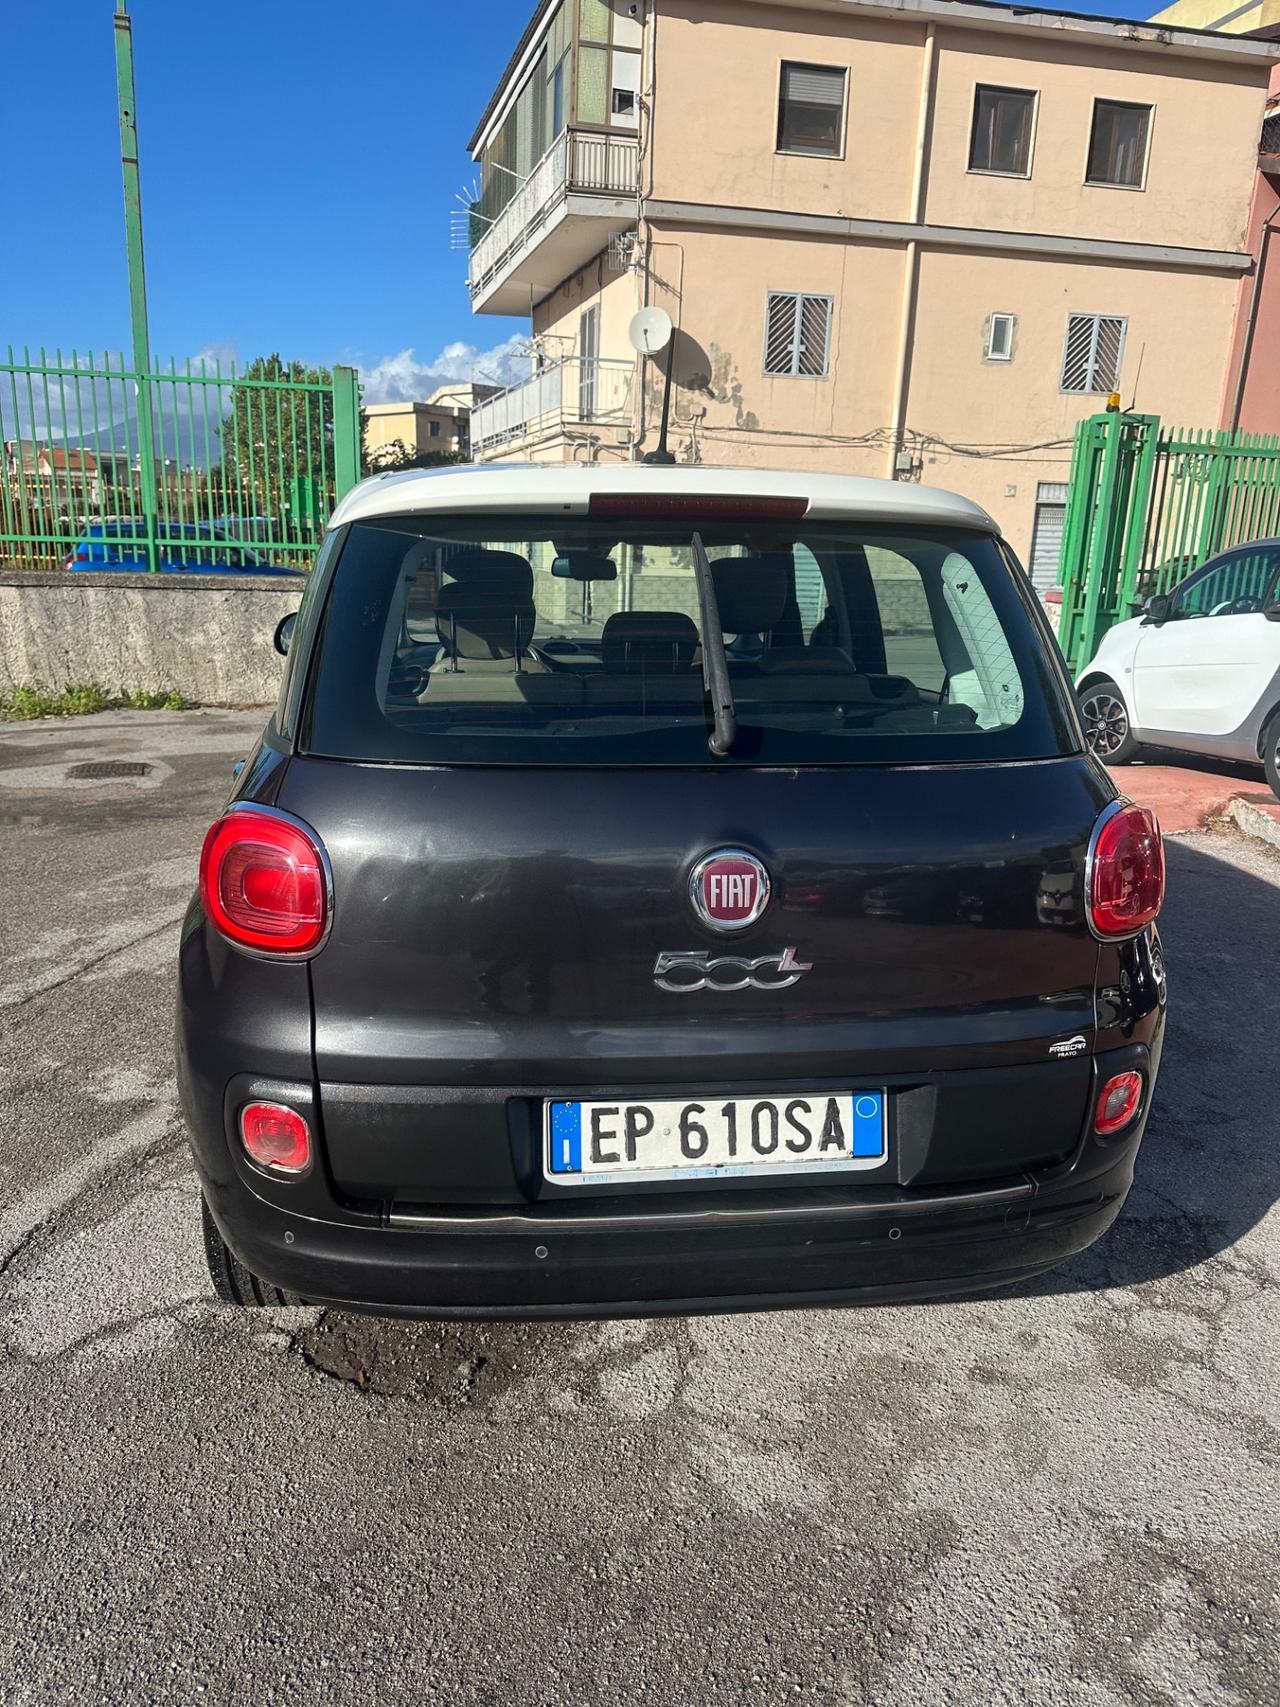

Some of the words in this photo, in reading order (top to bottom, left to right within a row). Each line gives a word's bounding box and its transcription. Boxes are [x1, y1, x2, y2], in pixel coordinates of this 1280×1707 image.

[710, 874, 754, 908] FIAT
[653, 946, 814, 992] 500L
[1048, 1042, 1087, 1053] FREECAR
[590, 1106, 655, 1164] EP
[678, 1097, 847, 1159] 610SA
[563, 1139, 570, 1164] I
